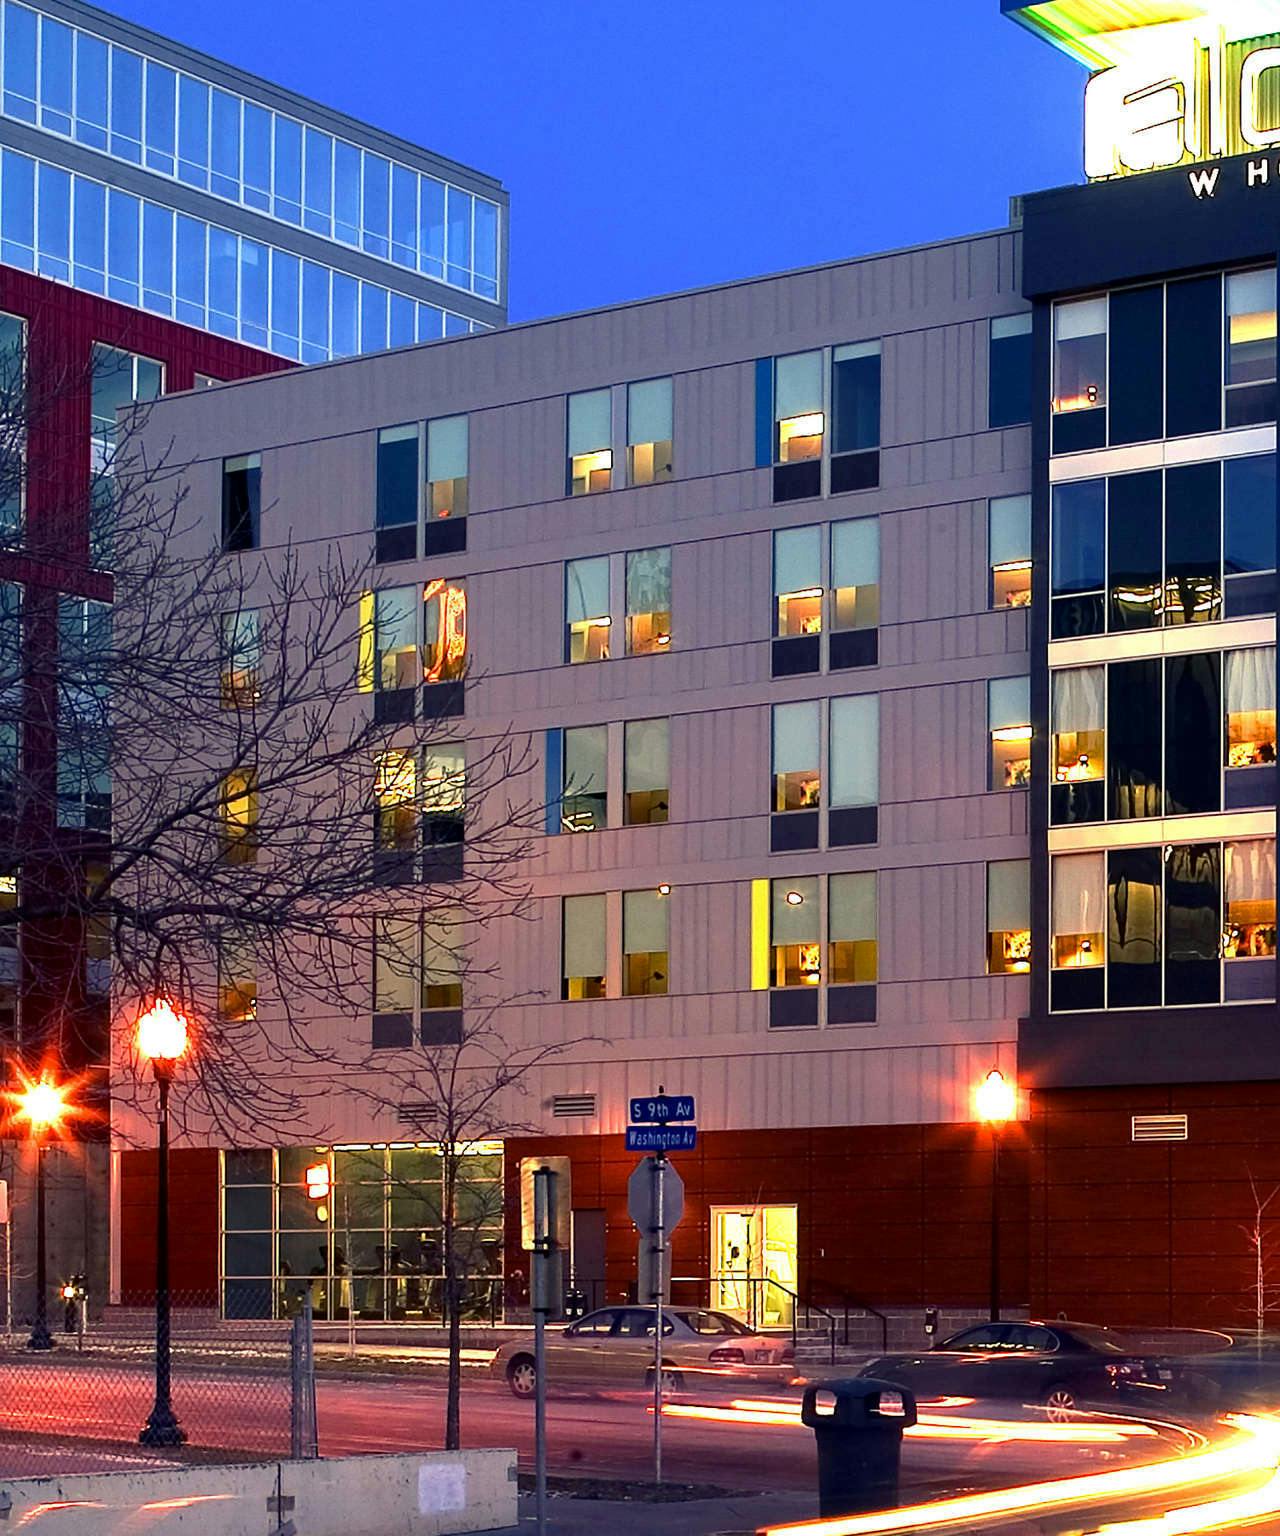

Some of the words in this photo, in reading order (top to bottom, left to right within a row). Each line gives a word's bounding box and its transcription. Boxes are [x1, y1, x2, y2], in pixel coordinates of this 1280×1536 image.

[1188, 166, 1220, 200] W
[633, 1103, 642, 1118] S
[647, 1102, 669, 1118] 9th
[675, 1101, 691, 1117] Av
[629, 1130, 681, 1150] Washington
[682, 1130, 694, 1145] Av
